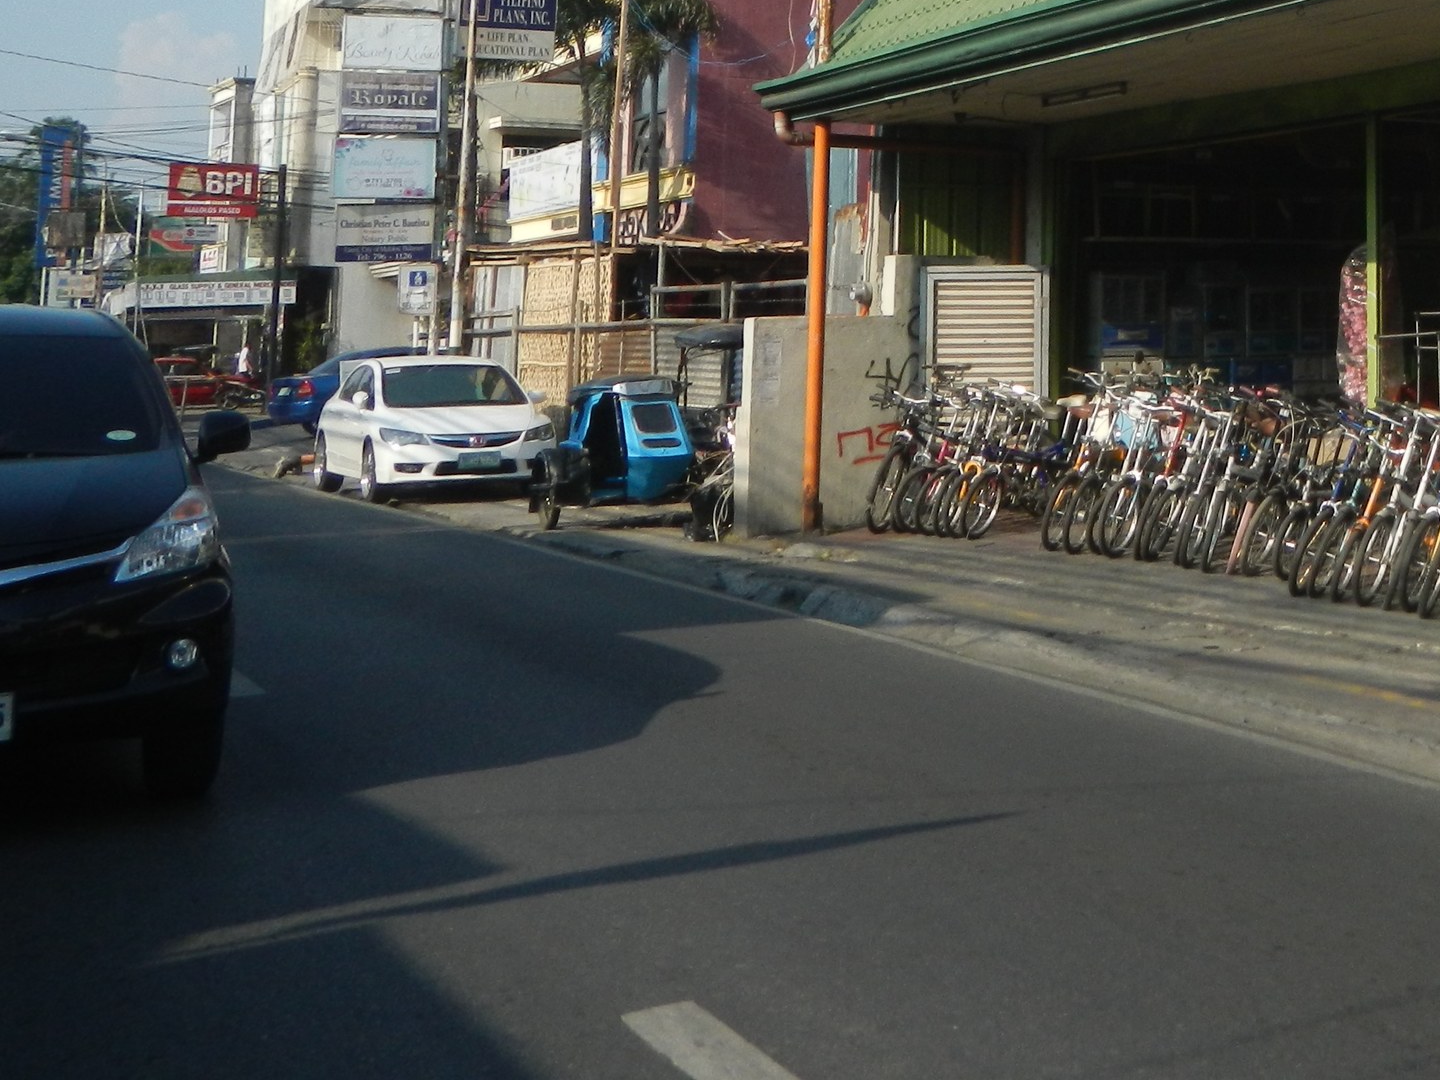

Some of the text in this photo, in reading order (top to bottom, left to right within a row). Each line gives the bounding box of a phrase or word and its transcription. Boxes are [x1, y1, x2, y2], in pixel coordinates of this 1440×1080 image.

[493, 8, 551, 26] PLANS, INC.
[487, 31, 529, 42] LIFE PLAN
[528, 46, 550, 57] PLAN
[351, 89, 429, 106] Royale
[205, 171, 253, 195] BPI
[340, 219, 372, 228] Christian
[373, 219, 391, 228] Peter
[402, 218, 430, 228] Bautista
